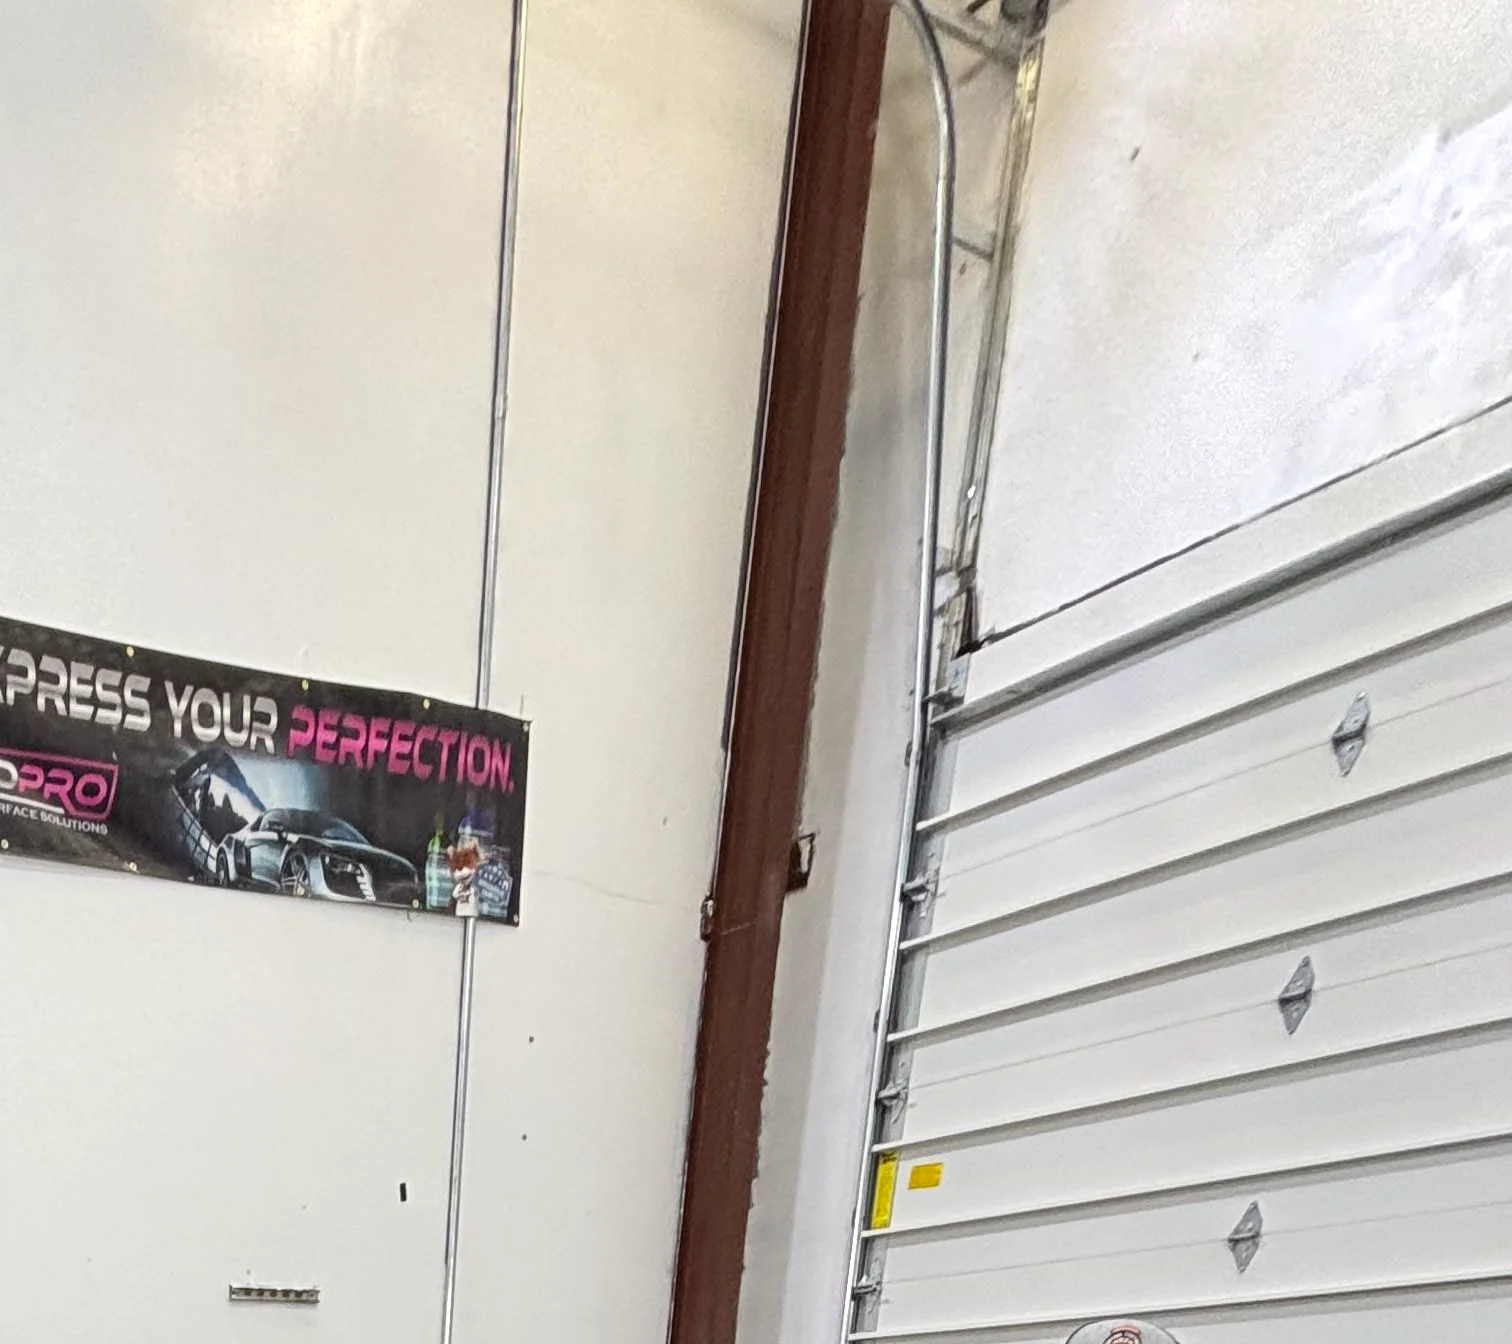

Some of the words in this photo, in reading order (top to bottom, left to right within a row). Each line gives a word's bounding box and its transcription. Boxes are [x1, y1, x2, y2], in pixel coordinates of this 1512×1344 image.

[164, 680, 278, 755] YOUR
[287, 703, 515, 794] PERFECTION.
[39, 810, 109, 836] SOLUTIONS
